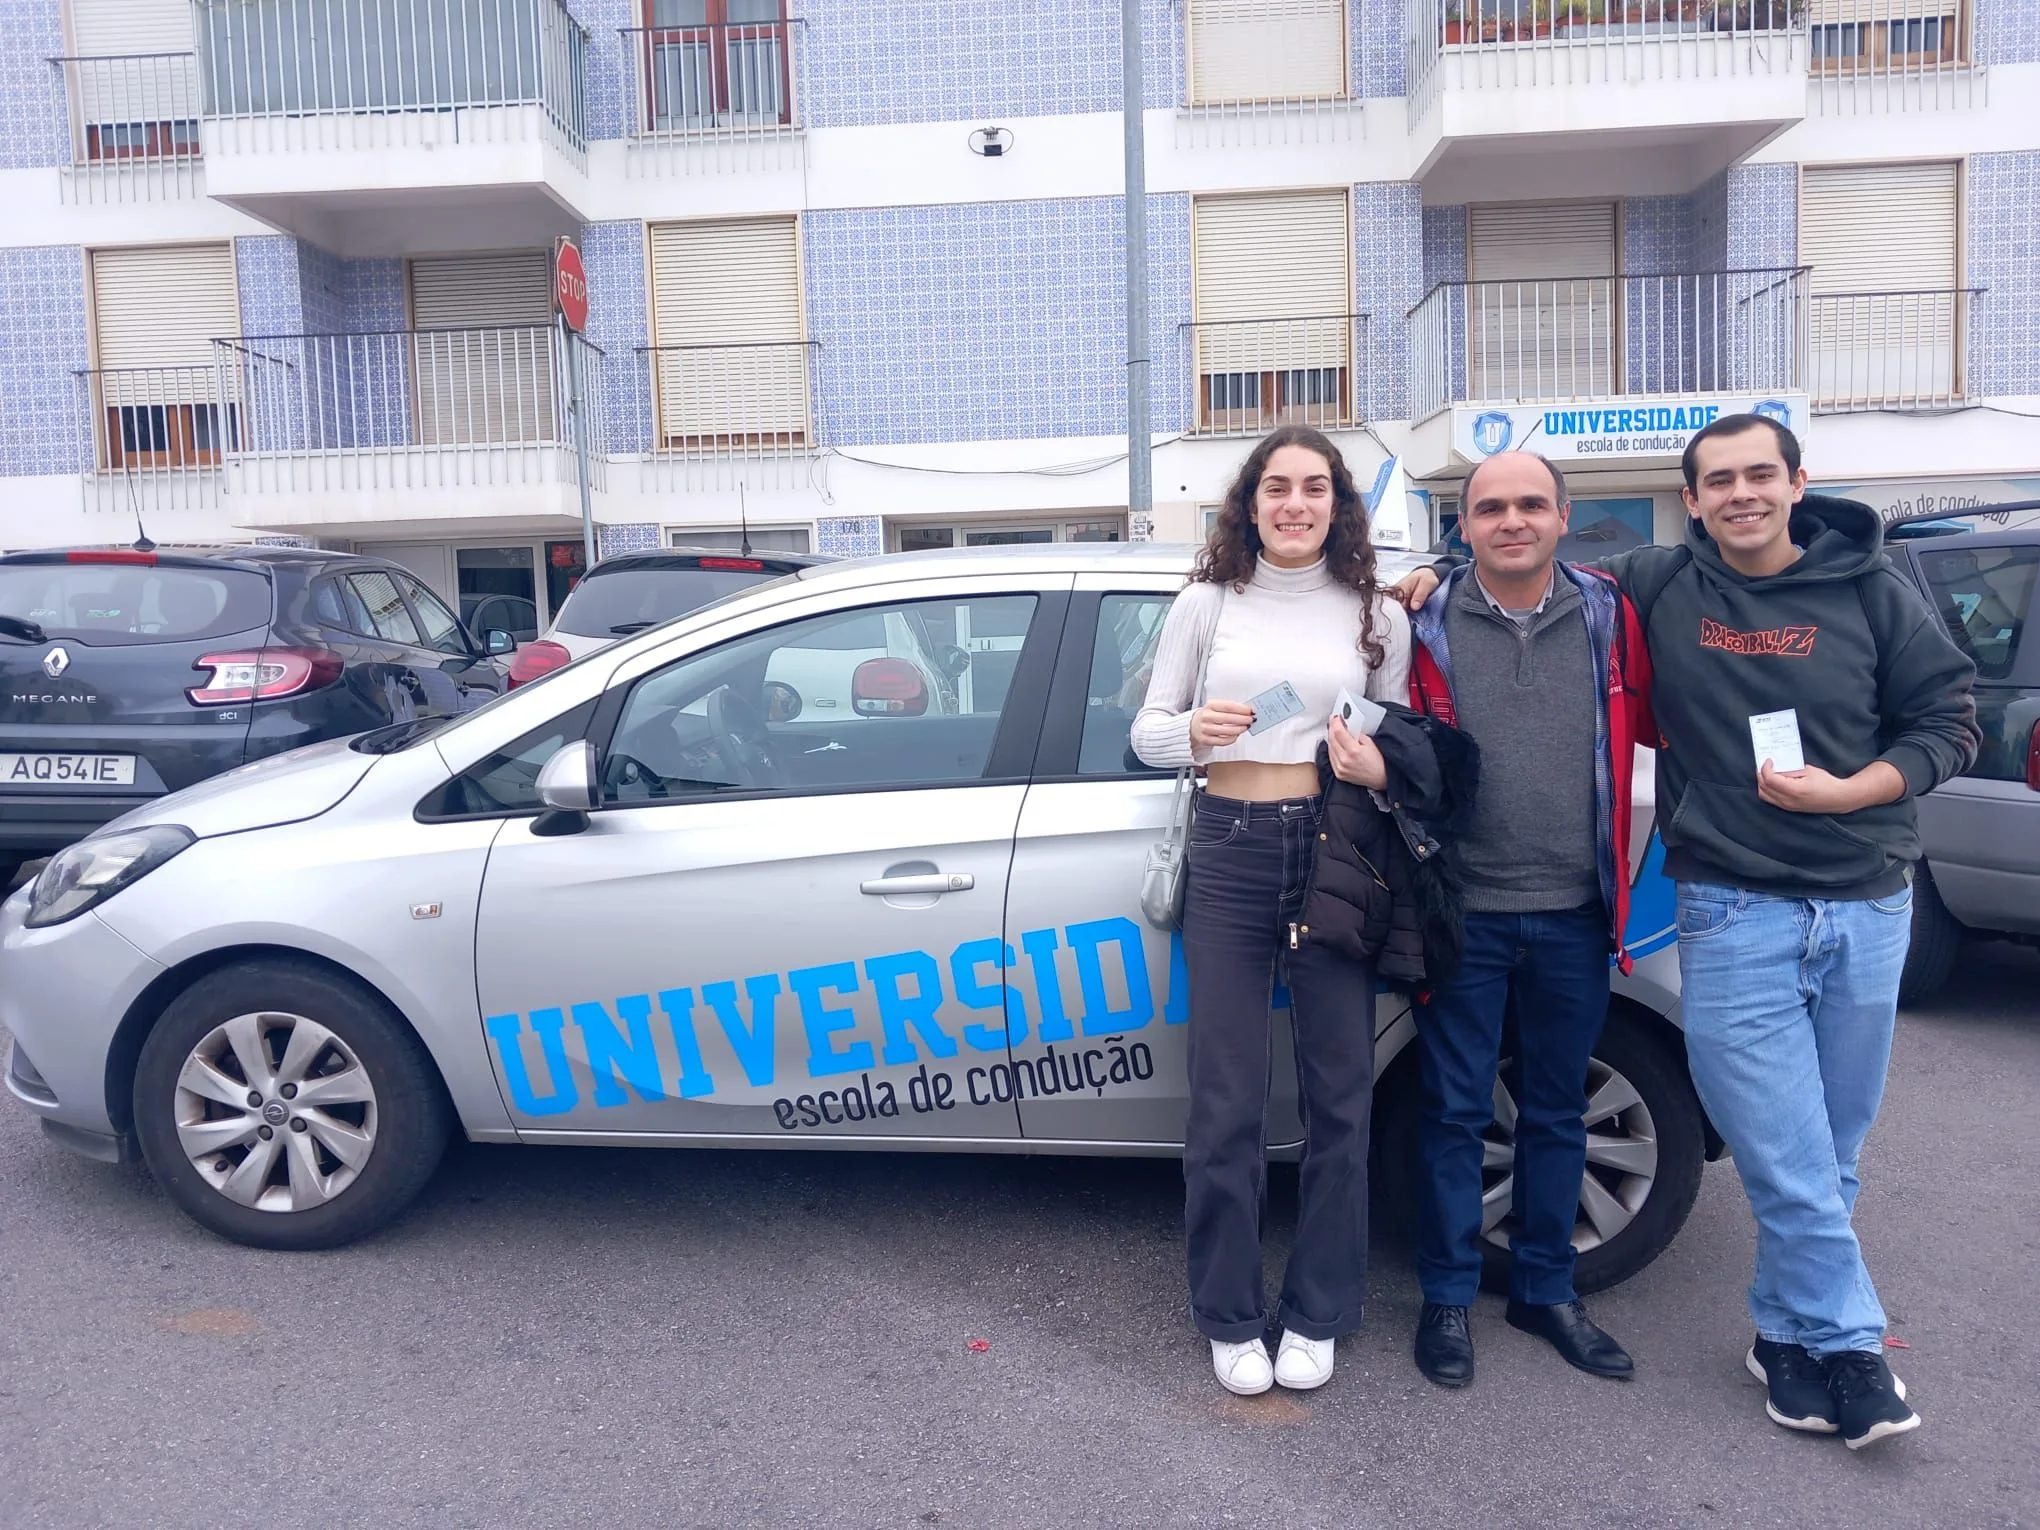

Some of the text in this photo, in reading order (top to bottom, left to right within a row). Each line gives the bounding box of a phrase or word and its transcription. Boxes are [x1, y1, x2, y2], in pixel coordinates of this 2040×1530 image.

[560, 270, 585, 302] STOP
[1544, 405, 1719, 435] UNIVERSIDADE
[1577, 433, 1686, 453] escola de condução
[1881, 498, 1913, 523] cola
[1917, 493, 1934, 514] de
[13, 694, 97, 704] MEGANE
[487, 914, 1191, 1118] UNIVERSID
[773, 1035, 1155, 1131] escola de condução
